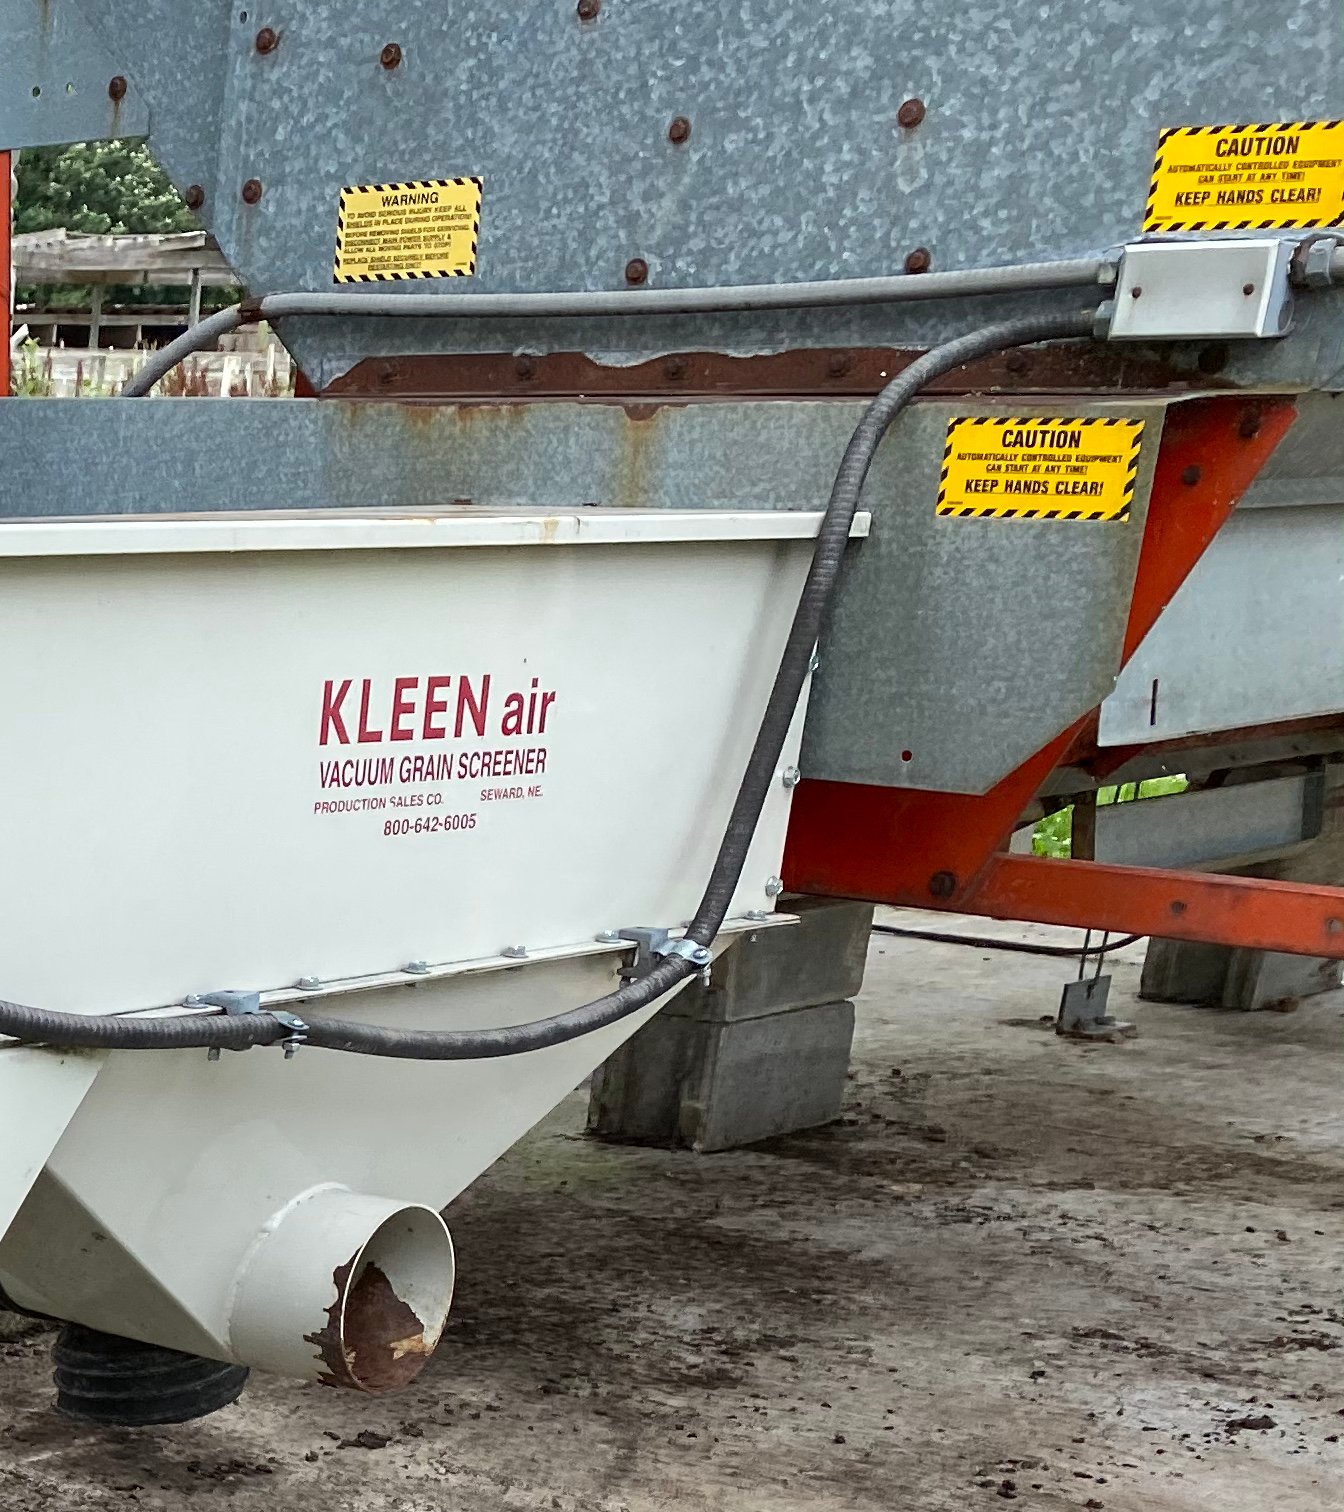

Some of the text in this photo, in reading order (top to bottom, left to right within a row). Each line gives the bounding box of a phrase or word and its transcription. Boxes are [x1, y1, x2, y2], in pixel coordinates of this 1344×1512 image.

[1215, 136, 1300, 158] CAUTION
[1167, 159, 1343, 174] AUTOMATICALLY CONTROLLED EQUIPMENT
[1198, 175, 1214, 185] CAN
[1218, 173, 1243, 184] START
[1246, 173, 1257, 183] AT
[1260, 172, 1277, 183] ANY
[381, 191, 439, 208] WARNING
[1175, 187, 1322, 207] KEEP HANDS CLEAR!
[1001, 429, 1082, 449] CAUTION
[956, 452, 1123, 464] AUTOMATICALLY CONTROLLED EQUIPMENT
[986, 464, 1002, 473] CAN
[1005, 464, 1029, 473] START
[1031, 464, 1042, 474] AT
[1045, 465, 1061, 474] ANY
[965, 479, 1104, 496] KEEP HANDS CLEAR!
[318, 674, 556, 746] KLEEN air
[319, 747, 547, 789] VACUUM GRAIN SCREENER
[313, 796, 387, 814] PRODUCTION
[388, 794, 424, 808] SALES
[480, 787, 524, 801] SEWARD,
[383, 813, 477, 836] 800-642-6005
